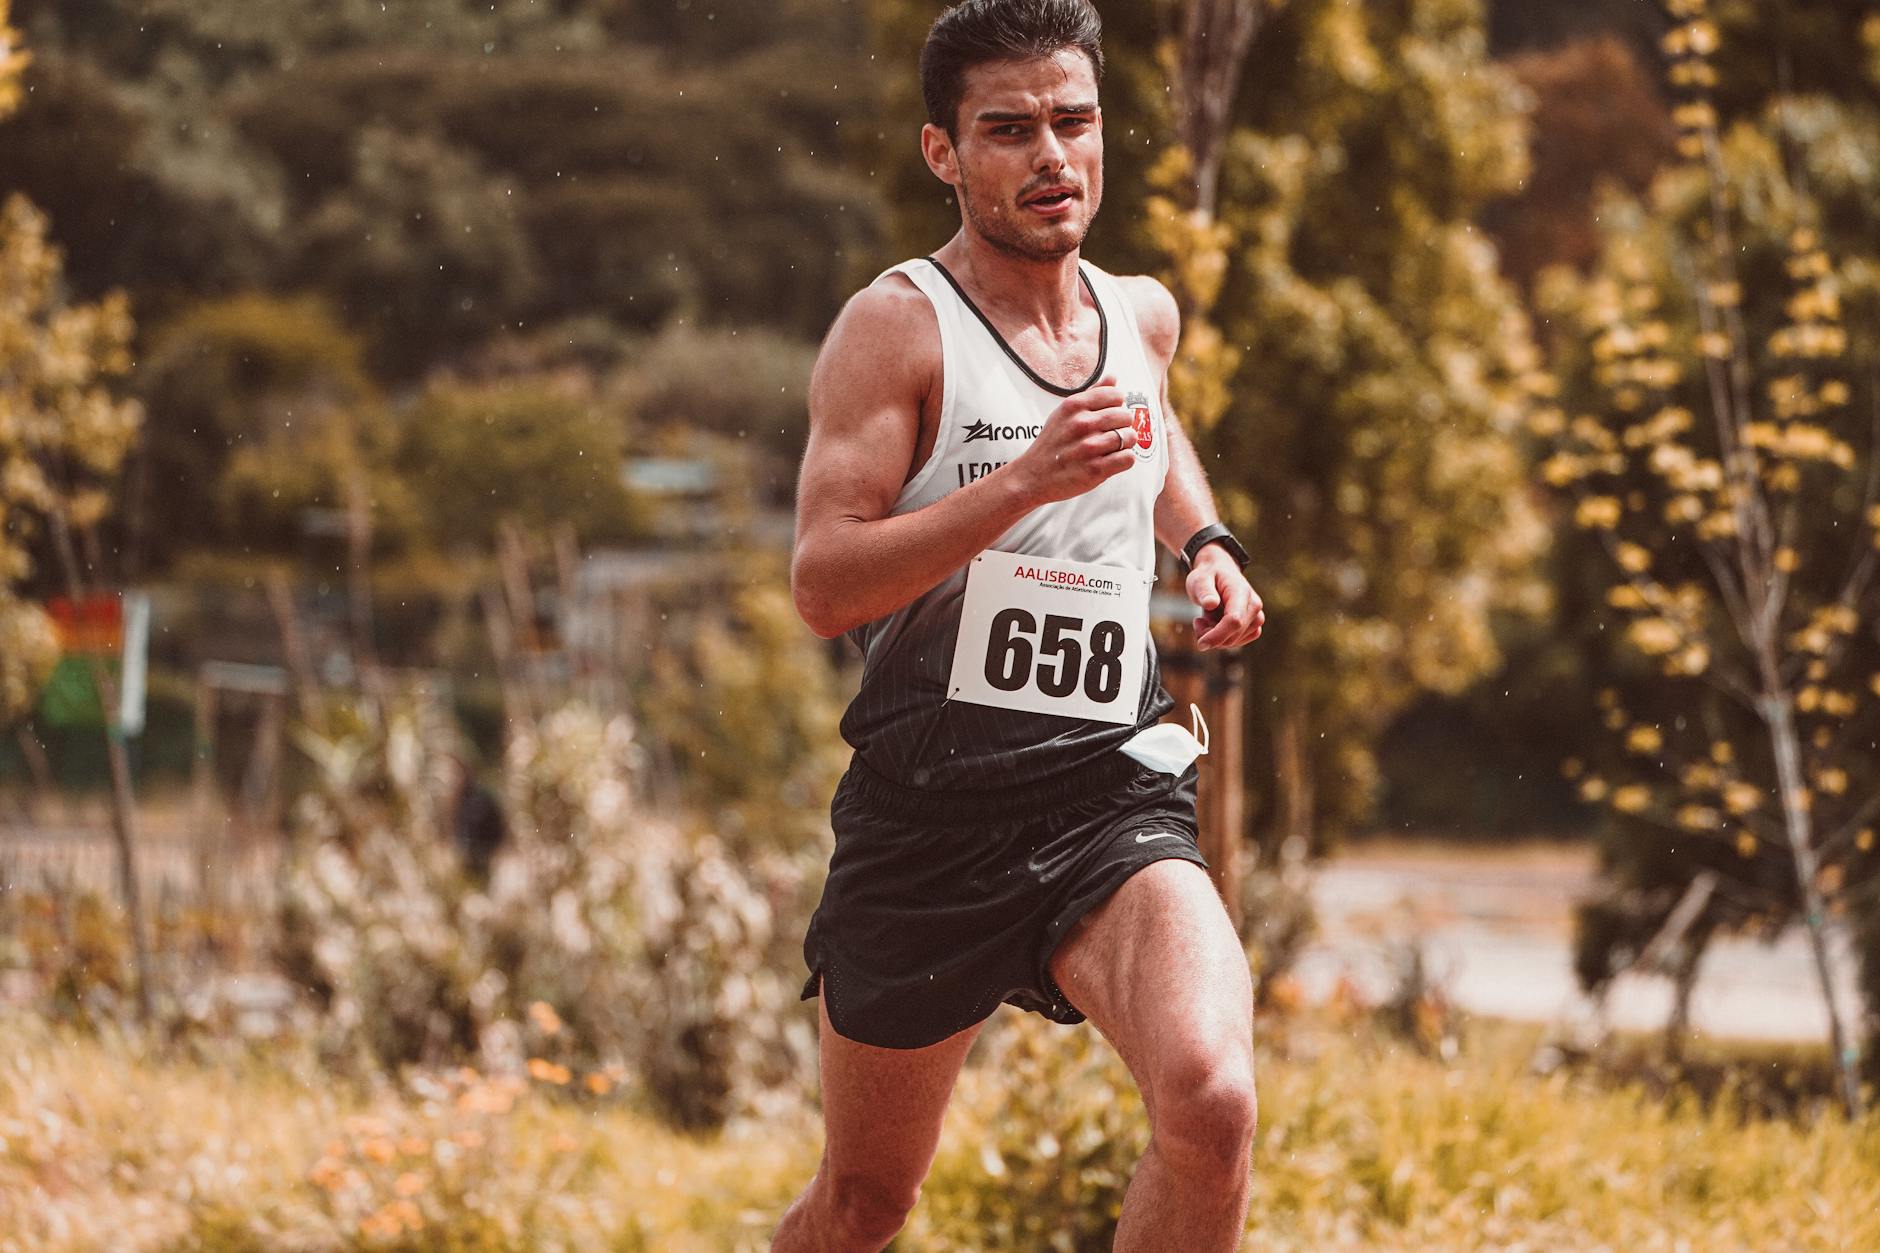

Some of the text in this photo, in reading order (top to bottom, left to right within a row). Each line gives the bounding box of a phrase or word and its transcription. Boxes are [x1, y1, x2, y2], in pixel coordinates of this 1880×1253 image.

[962, 421, 1043, 443] Aronic
[1014, 566, 1113, 590] AALISBOA.com
[1071, 586, 1092, 594] Atletismo
[984, 608, 1125, 703] 658
